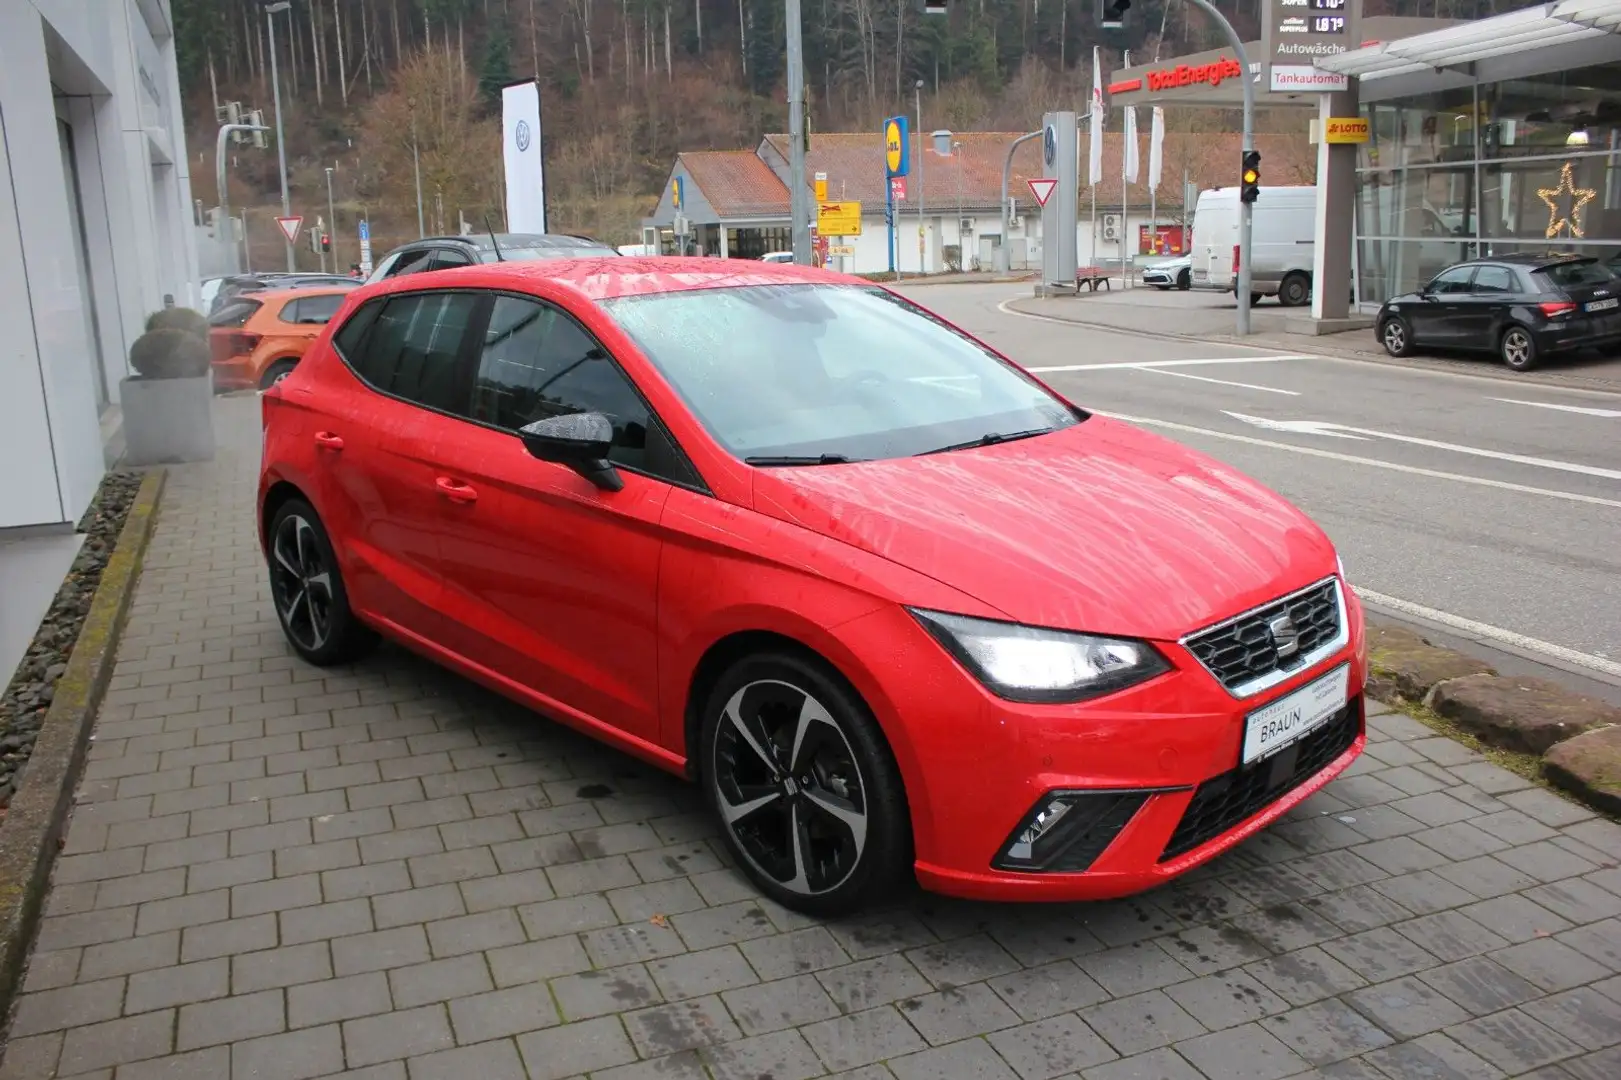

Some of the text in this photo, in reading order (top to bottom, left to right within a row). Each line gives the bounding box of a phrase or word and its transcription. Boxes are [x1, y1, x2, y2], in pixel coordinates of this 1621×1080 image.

[1277, 42, 1347, 55] Autowäsche
[1146, 55, 1241, 92] TotalEnergies
[1275, 72, 1345, 84] Tankautomat
[1340, 124, 1367, 133] LOTTO
[1260, 707, 1301, 743] BRAUN
